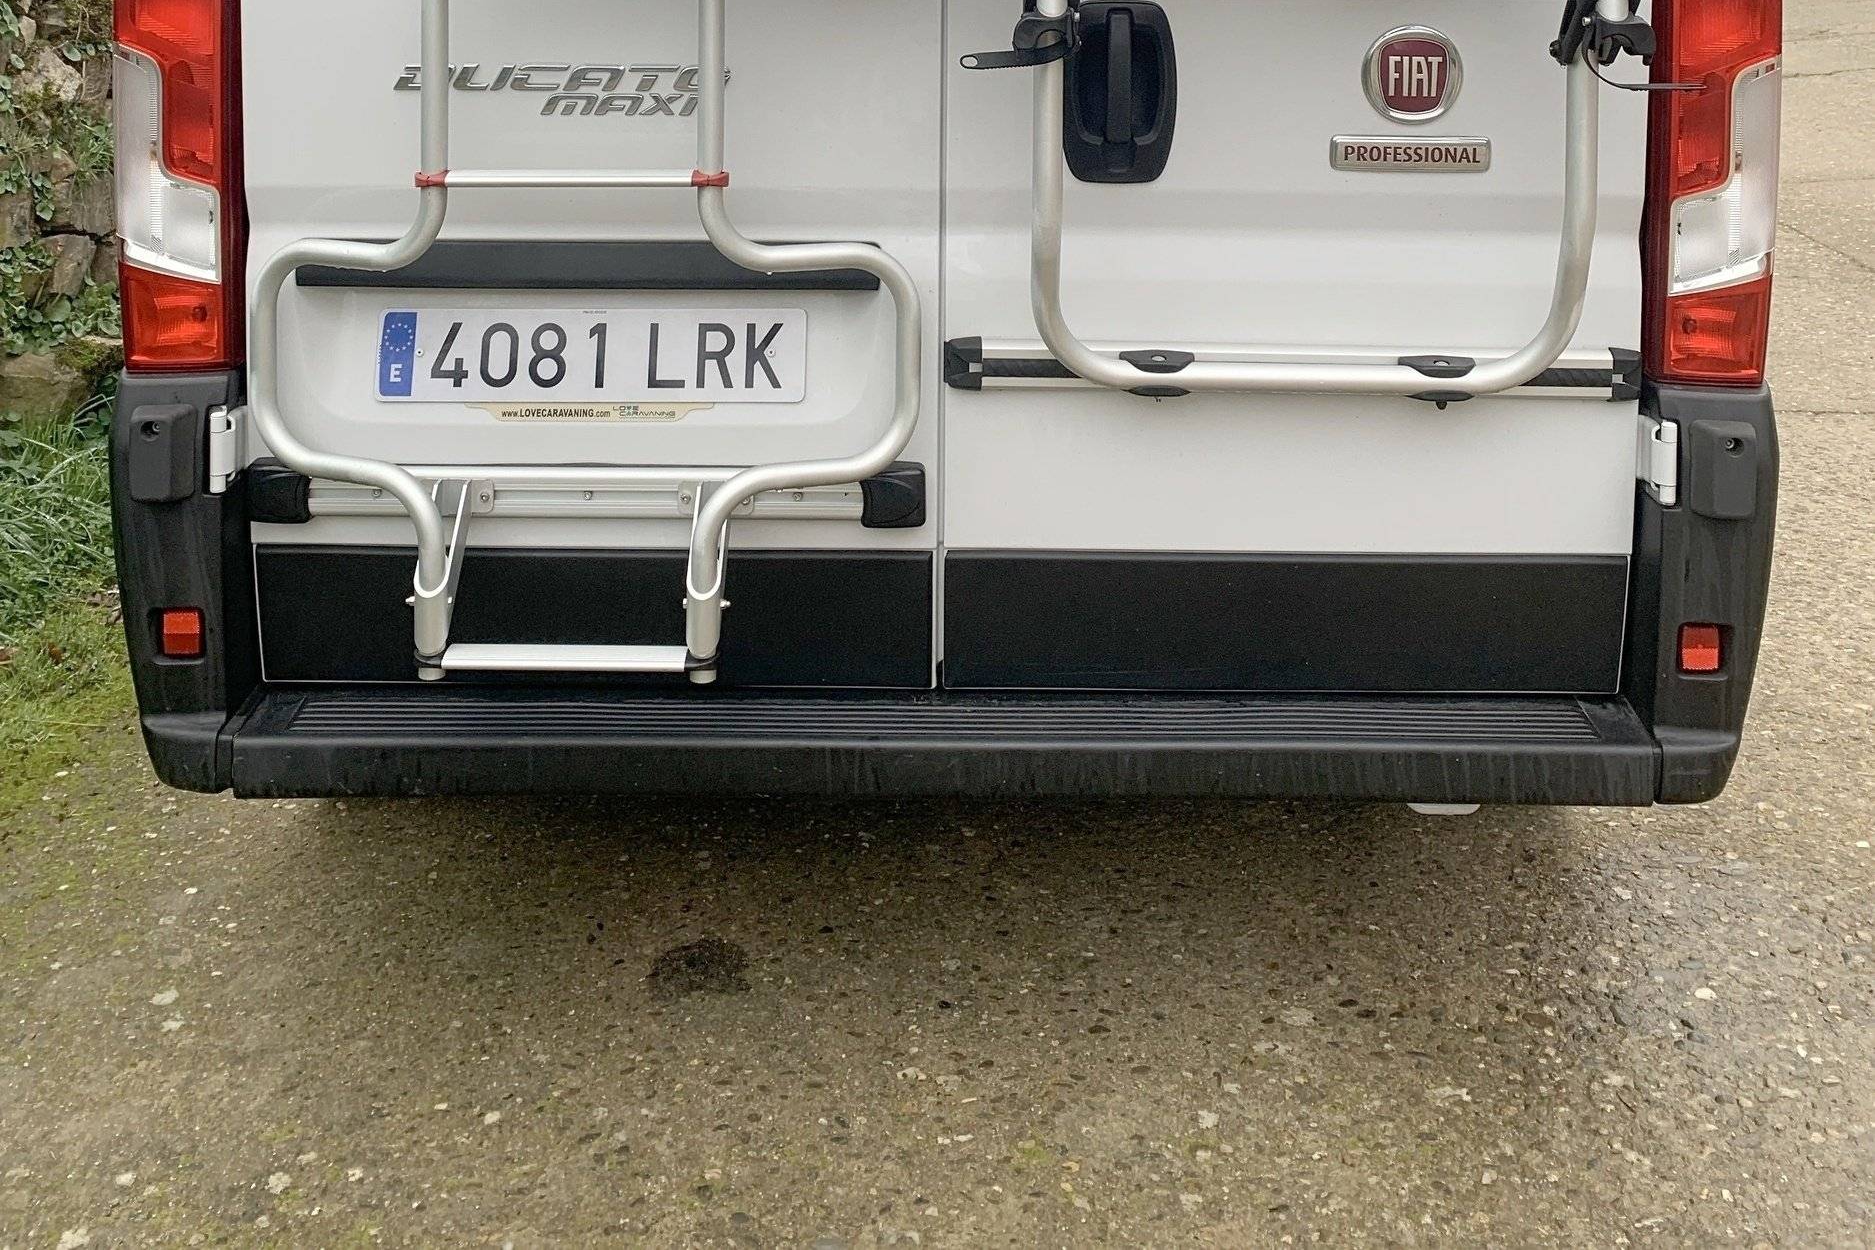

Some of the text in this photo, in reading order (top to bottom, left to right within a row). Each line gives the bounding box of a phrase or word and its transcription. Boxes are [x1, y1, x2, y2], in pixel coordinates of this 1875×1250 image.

[1388, 55, 1443, 97] FIAT
[540, 93, 699, 116] MAXI
[1343, 145, 1481, 164] PROFESSIONAL
[430, 322, 784, 389] 4081 LRK
[389, 363, 403, 383] E
[501, 408, 611, 418] www.LOVECARAVANING.com
